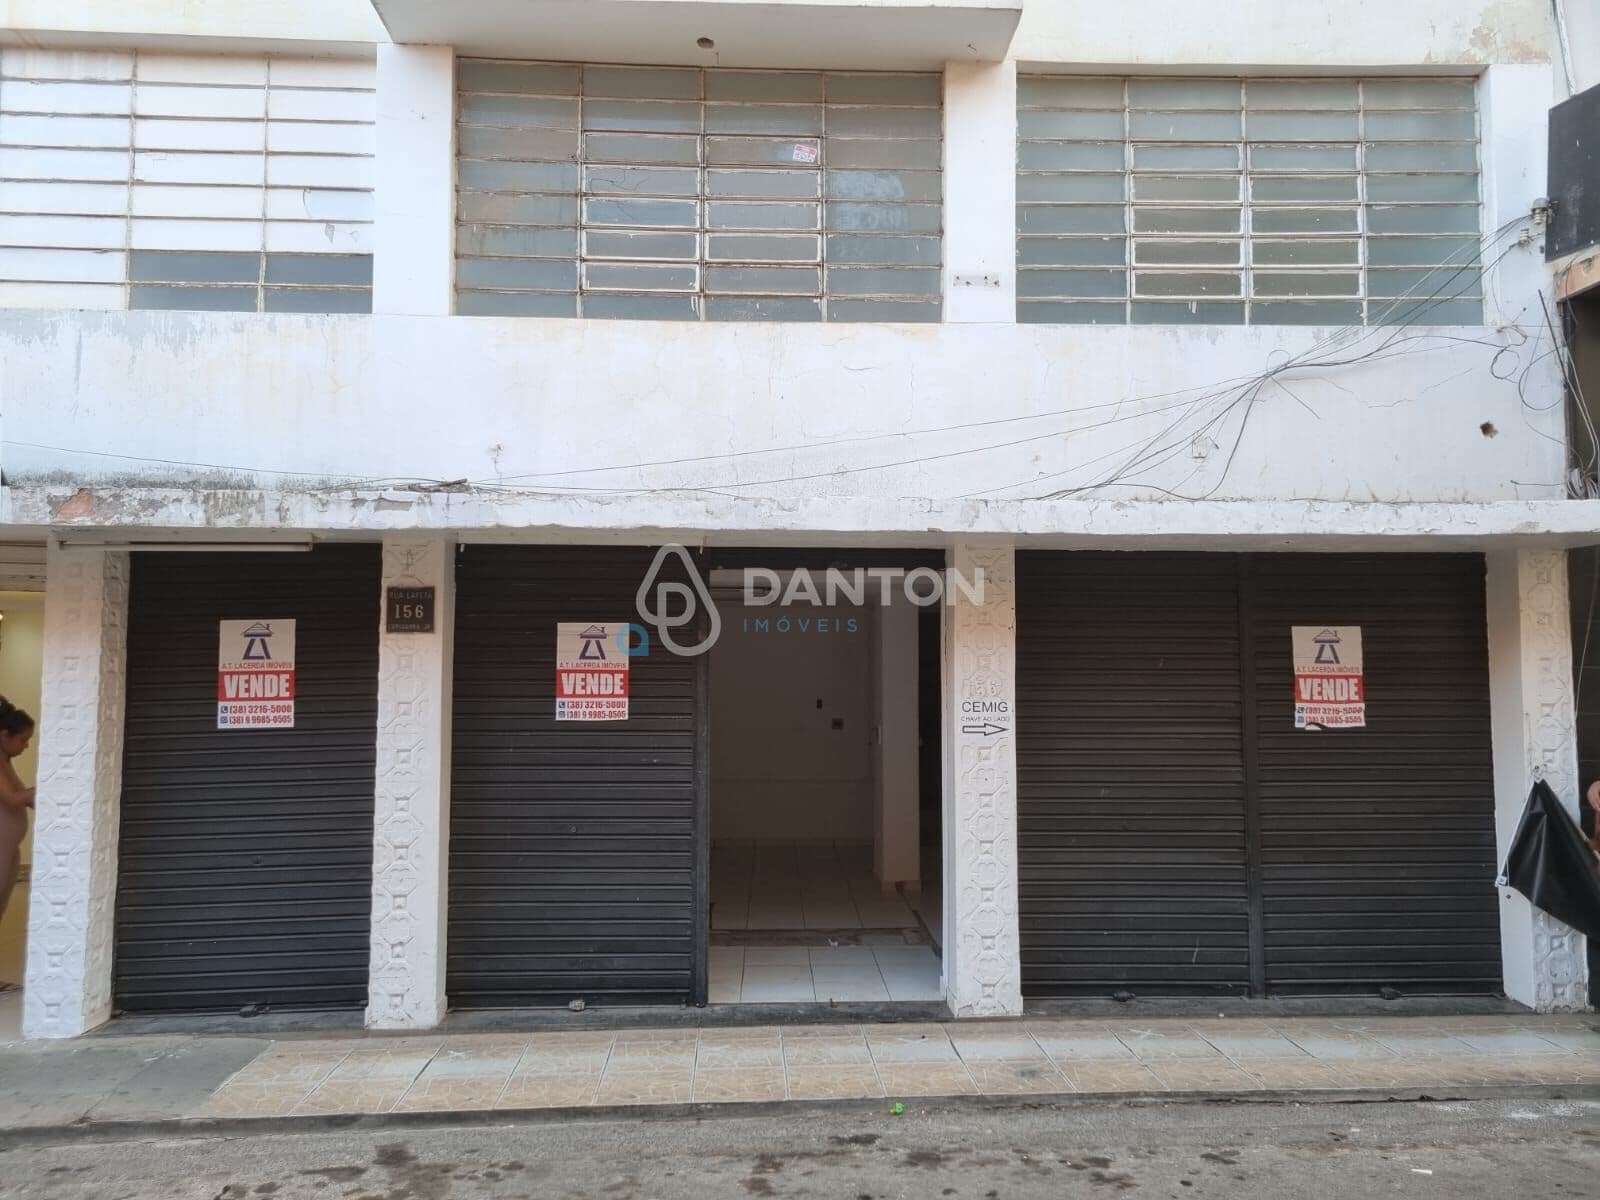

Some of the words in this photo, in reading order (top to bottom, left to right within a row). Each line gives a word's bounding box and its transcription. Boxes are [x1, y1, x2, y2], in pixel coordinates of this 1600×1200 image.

[395, 604, 424, 619] 156
[224, 674, 290, 698] VENDE
[561, 673, 624, 695] VENDE
[1298, 678, 1359, 701] VENDE
[230, 706, 246, 714] (38)
[248, 705, 292, 714] 3216-5000
[567, 701, 583, 709] (38)
[585, 701, 626, 709] 3216-5000
[962, 701, 1008, 713] CEMIG
[230, 716, 244, 724] (38)
[567, 711, 581, 719] (38)
